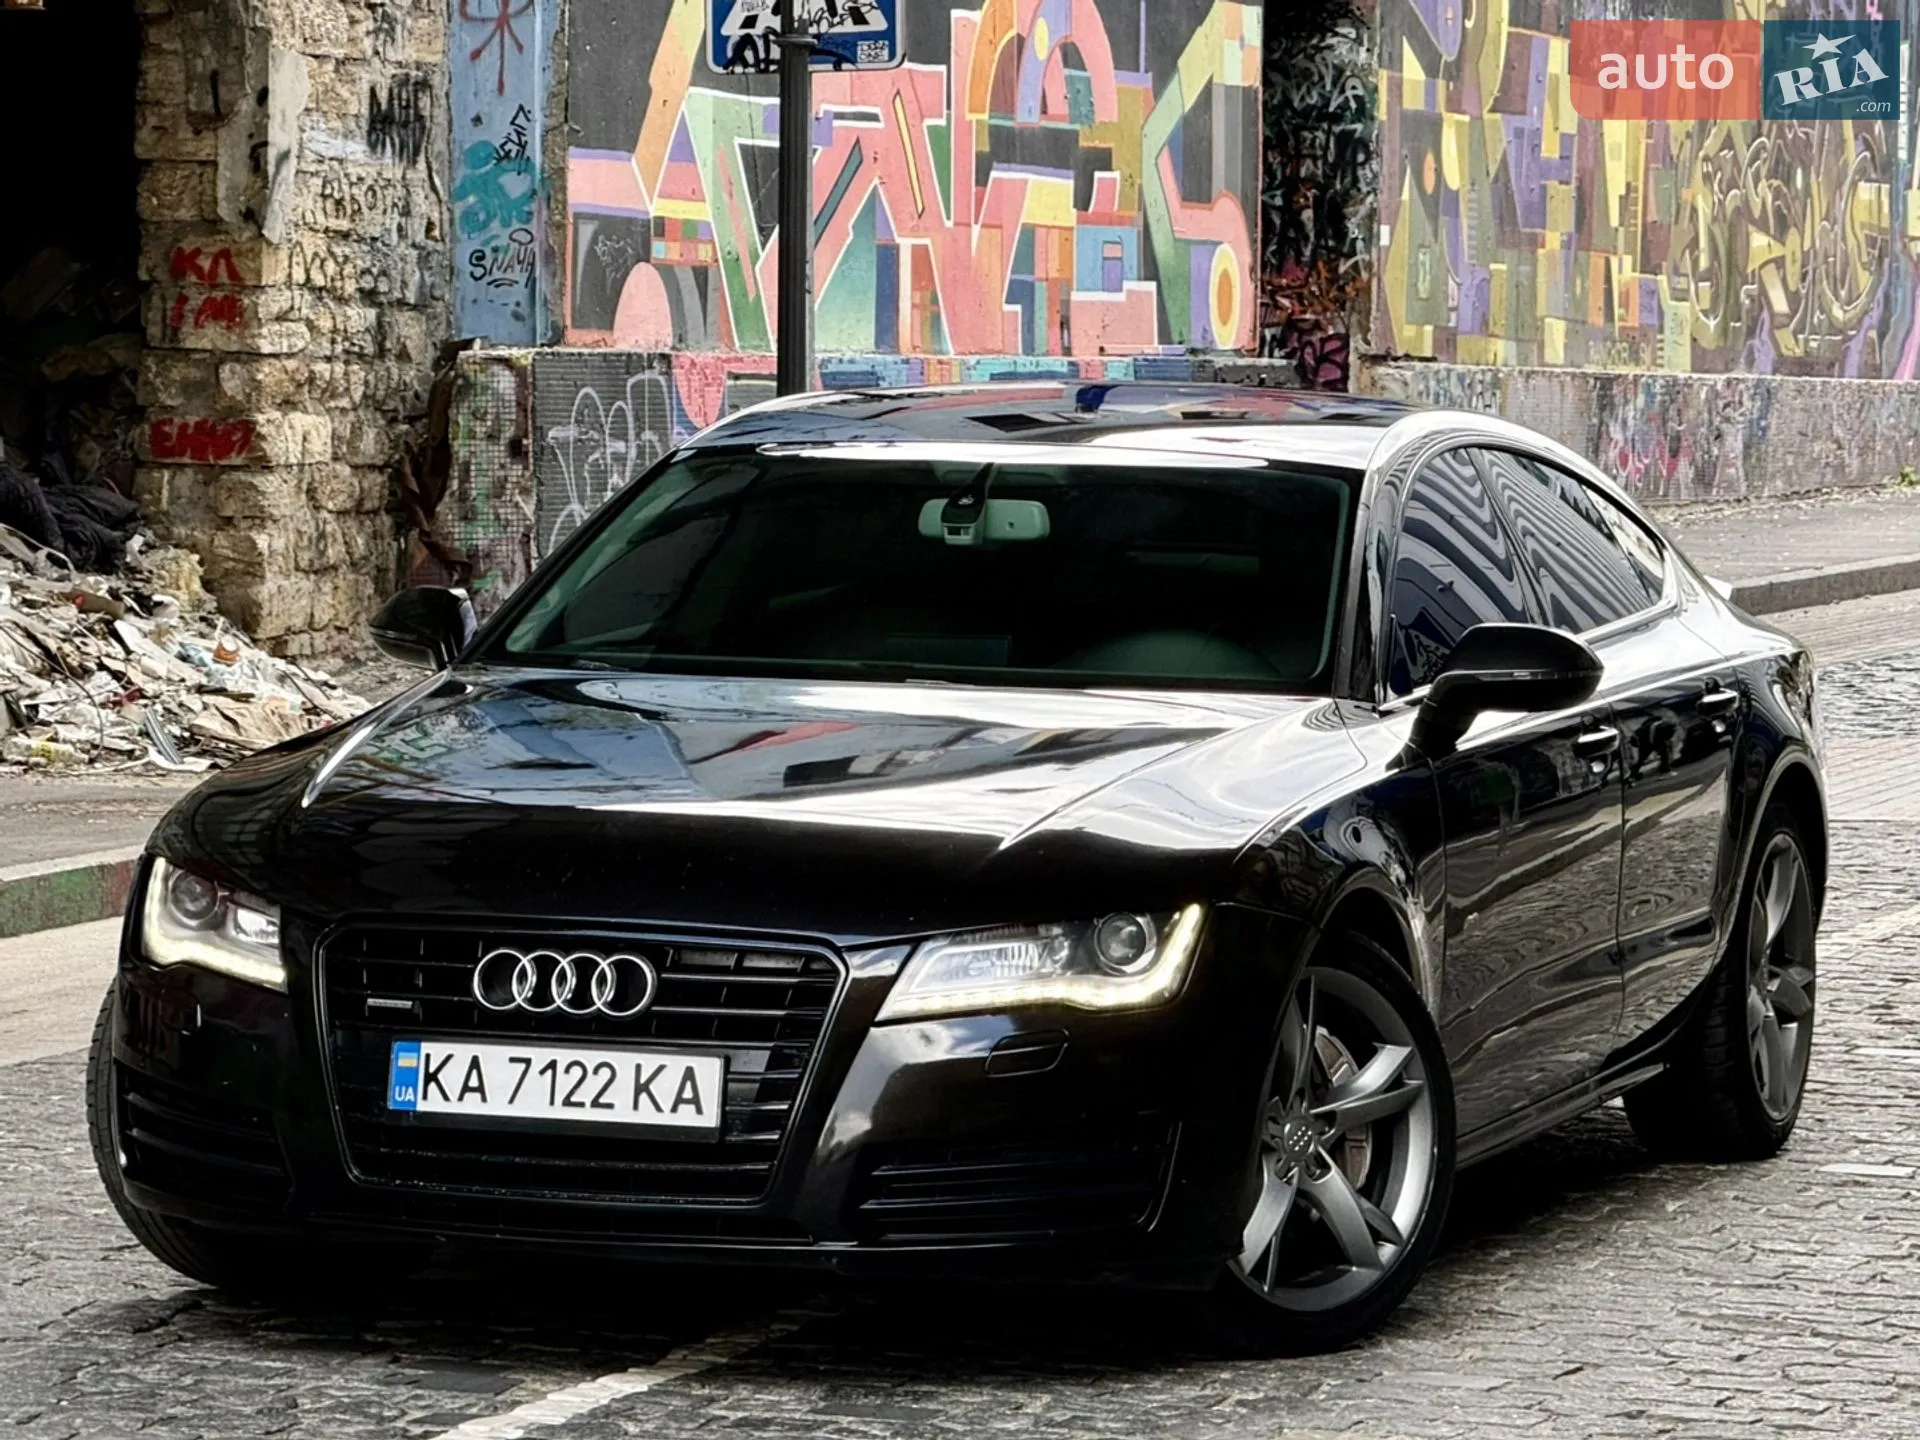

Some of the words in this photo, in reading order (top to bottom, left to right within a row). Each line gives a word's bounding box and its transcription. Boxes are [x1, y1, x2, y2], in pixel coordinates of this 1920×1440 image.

[394, 1085, 415, 1102] UA
[422, 1052, 488, 1104] KA
[507, 1056, 618, 1110] 7122
[632, 1062, 704, 1115] KA
